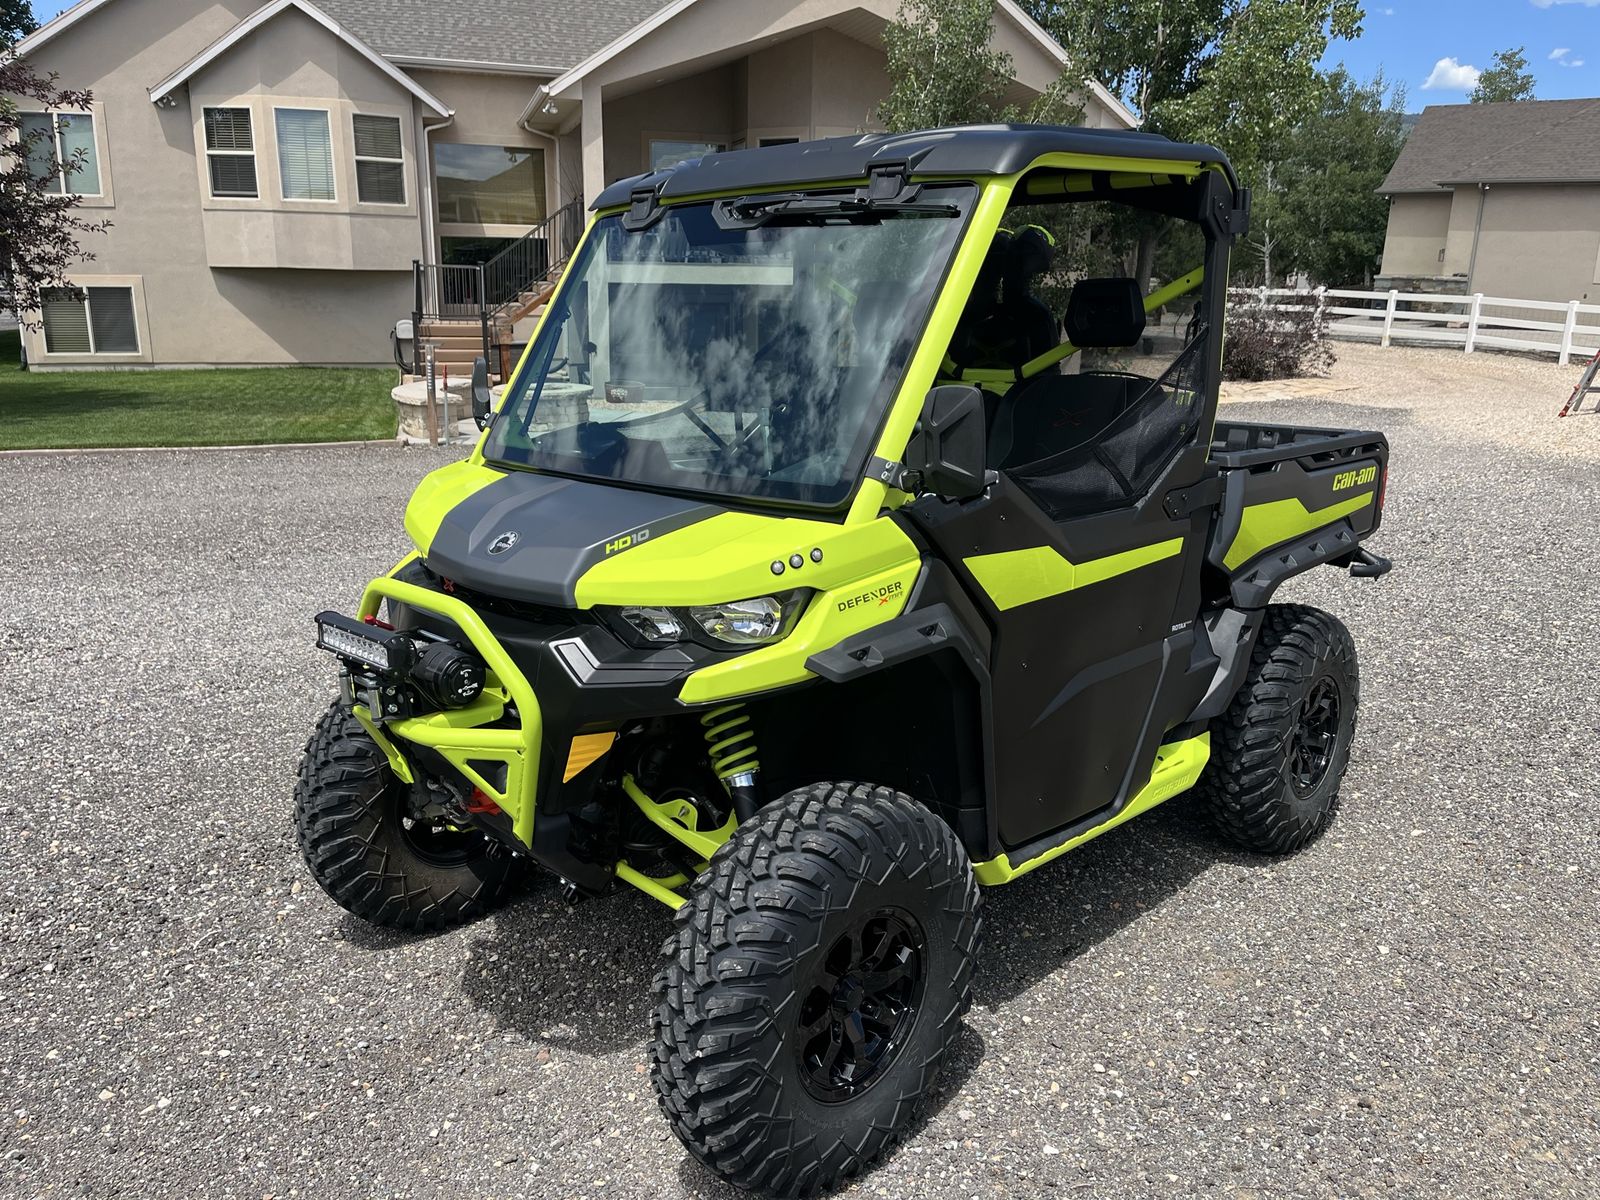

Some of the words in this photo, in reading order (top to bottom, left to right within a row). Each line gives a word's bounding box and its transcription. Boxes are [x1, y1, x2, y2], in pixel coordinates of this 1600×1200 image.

[1332, 466, 1377, 492] can-am
[605, 528, 650, 555] HD10
[837, 581, 903, 612] DEFENDER
